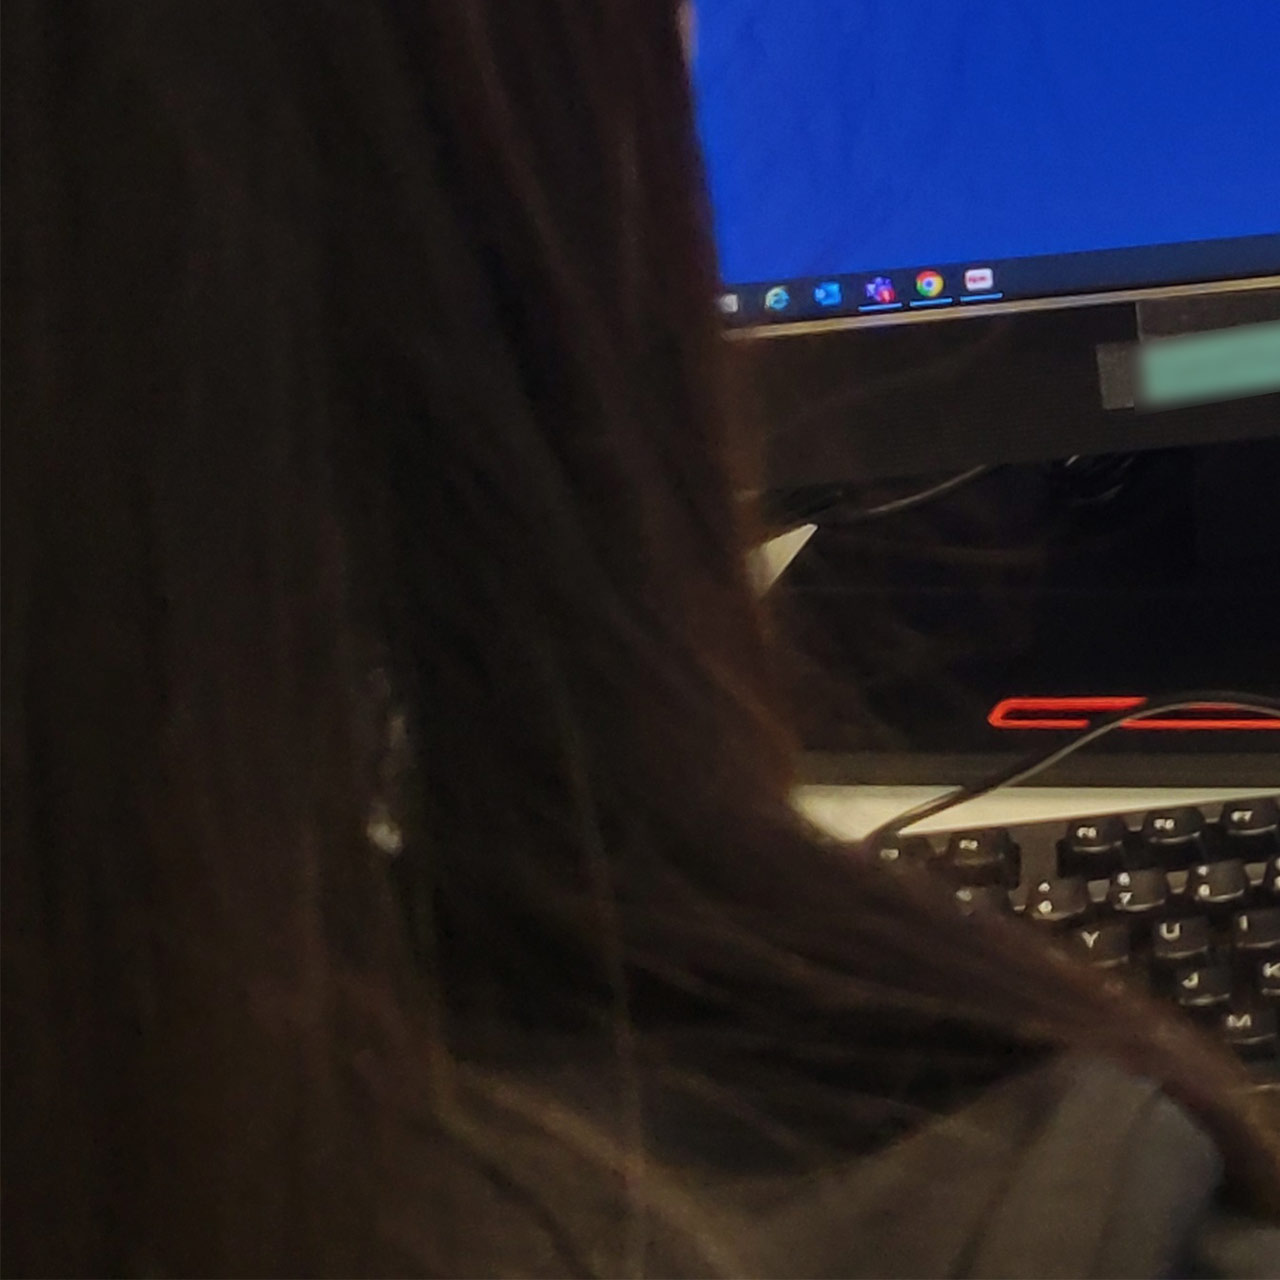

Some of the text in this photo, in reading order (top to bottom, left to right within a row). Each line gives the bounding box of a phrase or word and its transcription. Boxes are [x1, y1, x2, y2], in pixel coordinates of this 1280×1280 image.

[1081, 929, 1101, 949] Y
[1160, 922, 1181, 940] U
[1181, 970, 1199, 990] J
[1226, 1012, 1252, 1029] M
